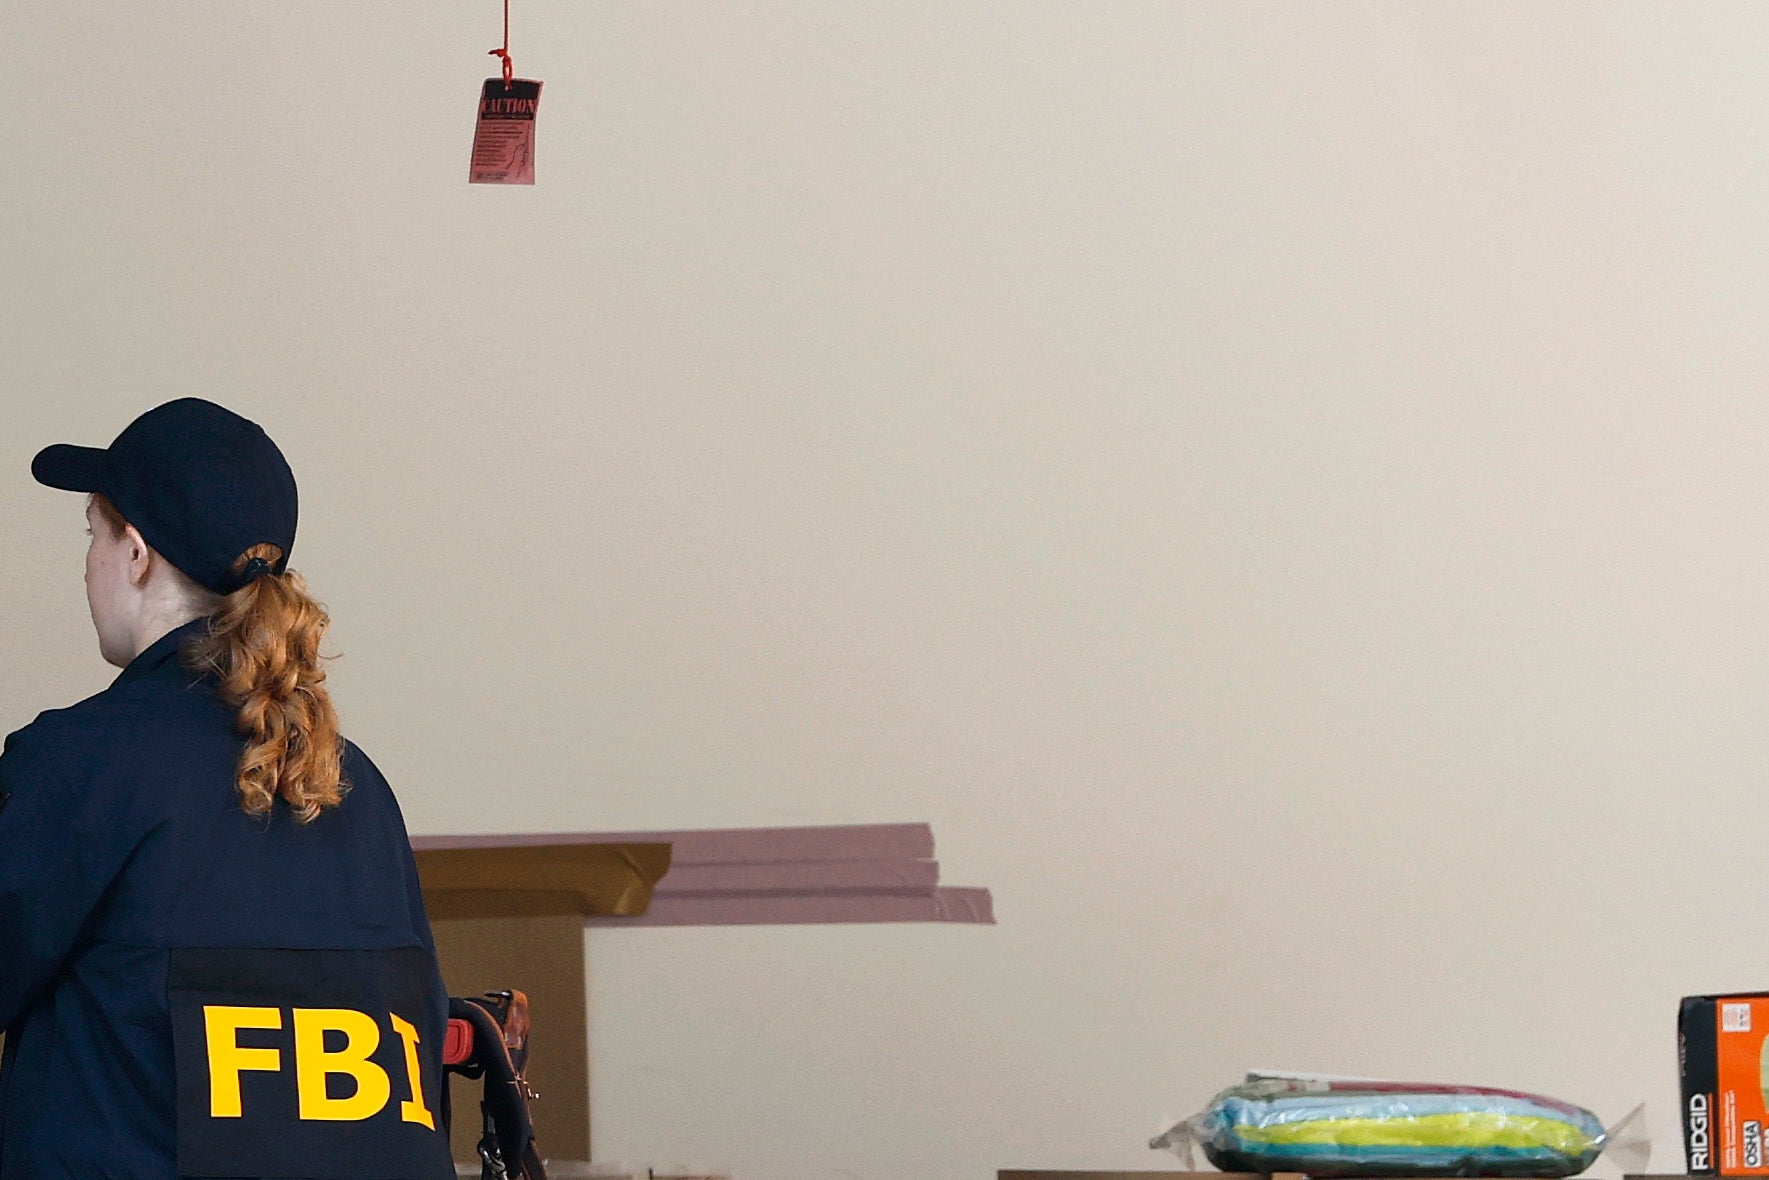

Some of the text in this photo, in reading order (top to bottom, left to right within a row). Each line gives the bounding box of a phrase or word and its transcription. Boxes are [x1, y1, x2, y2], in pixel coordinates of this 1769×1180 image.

[203, 1005, 436, 1131] FBI
[1689, 1093, 1709, 1171] RIDGID
[1745, 1121, 1758, 1166] OSHA
